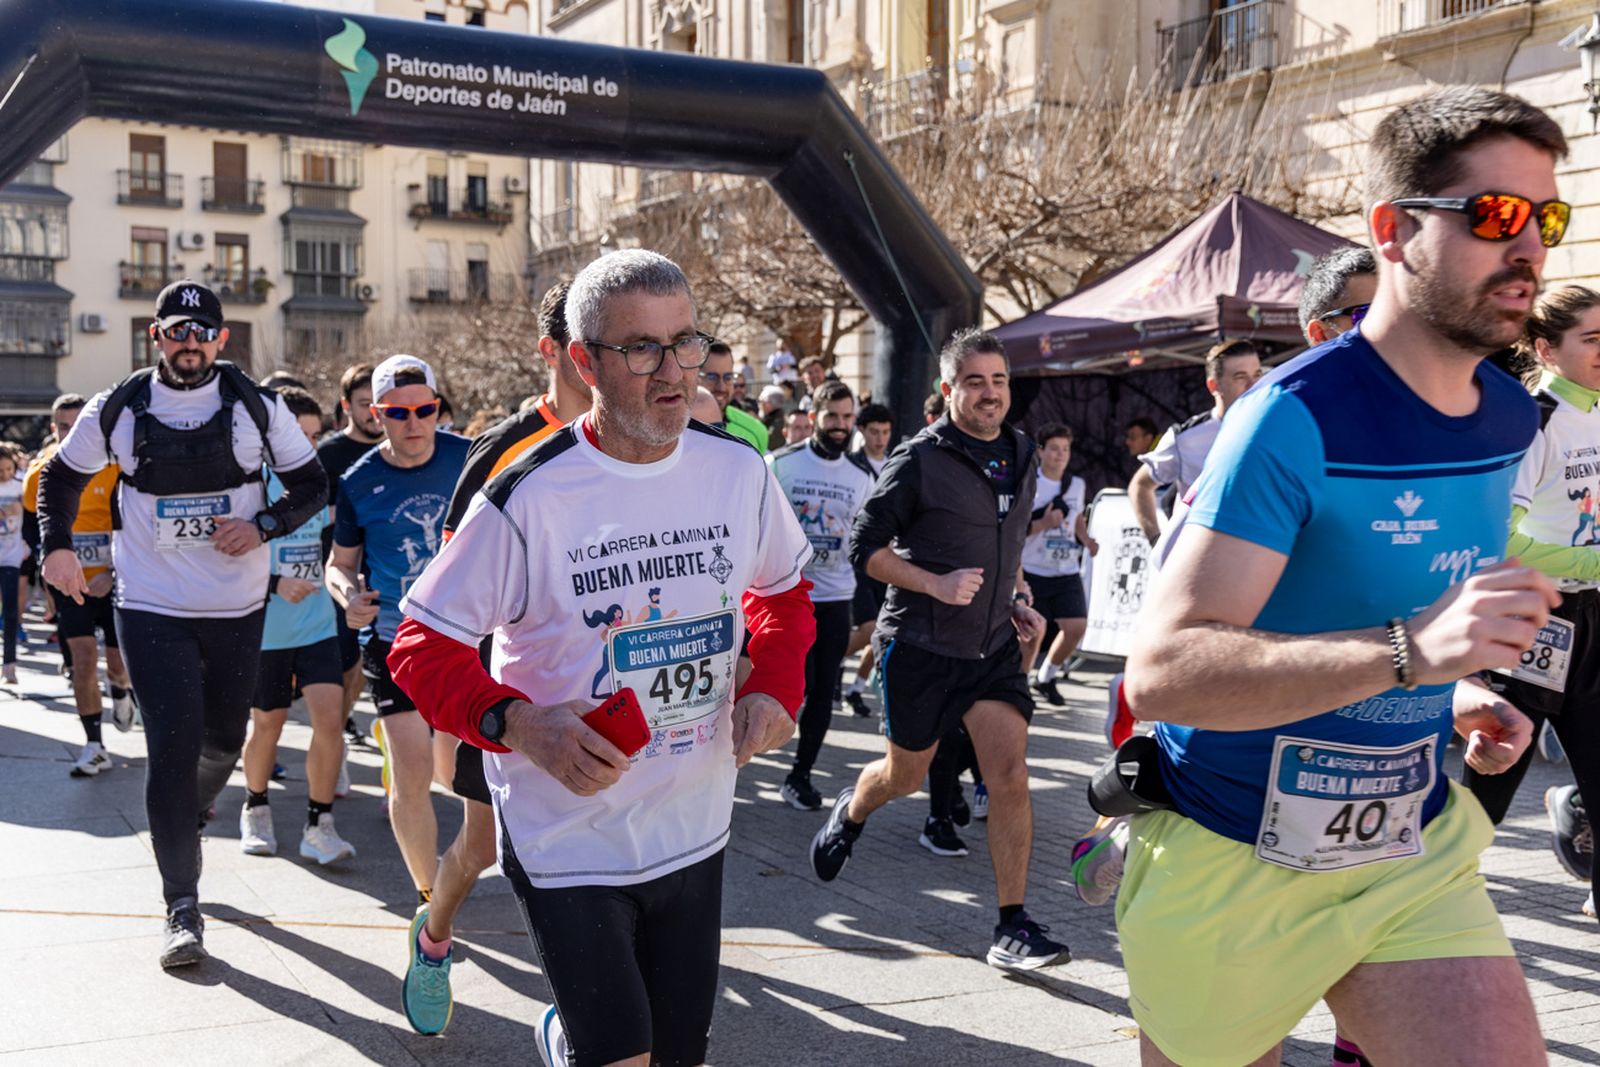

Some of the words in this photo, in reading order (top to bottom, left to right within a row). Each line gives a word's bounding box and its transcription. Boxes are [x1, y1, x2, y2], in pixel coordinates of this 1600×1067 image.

[386, 53, 488, 83] Patronato
[493, 65, 588, 96] Municipal
[593, 78, 619, 97] de
[385, 78, 482, 105] Deportes
[486, 90, 513, 110] de
[517, 92, 567, 116] Jaén
[181, 288, 201, 307] NY
[173, 517, 217, 538] 233
[567, 548, 584, 564] VI
[588, 533, 658, 560] CARRERA
[661, 524, 730, 546] CAMINATA
[571, 563, 634, 597] BUENA
[637, 551, 707, 583] MUERTE
[627, 635, 638, 646] VI
[639, 628, 684, 644] CARRERA
[685, 619, 723, 637] CAMINATA
[628, 646, 667, 666] BUENA
[669, 638, 708, 660] MUERTE
[649, 658, 714, 704] 495
[1317, 755, 1375, 771] CARRERA
[1377, 752, 1421, 771] CAMINATA
[1296, 771, 1347, 794] BUENA
[1349, 775, 1403, 795] MUERTE
[1324, 800, 1387, 843] 40
